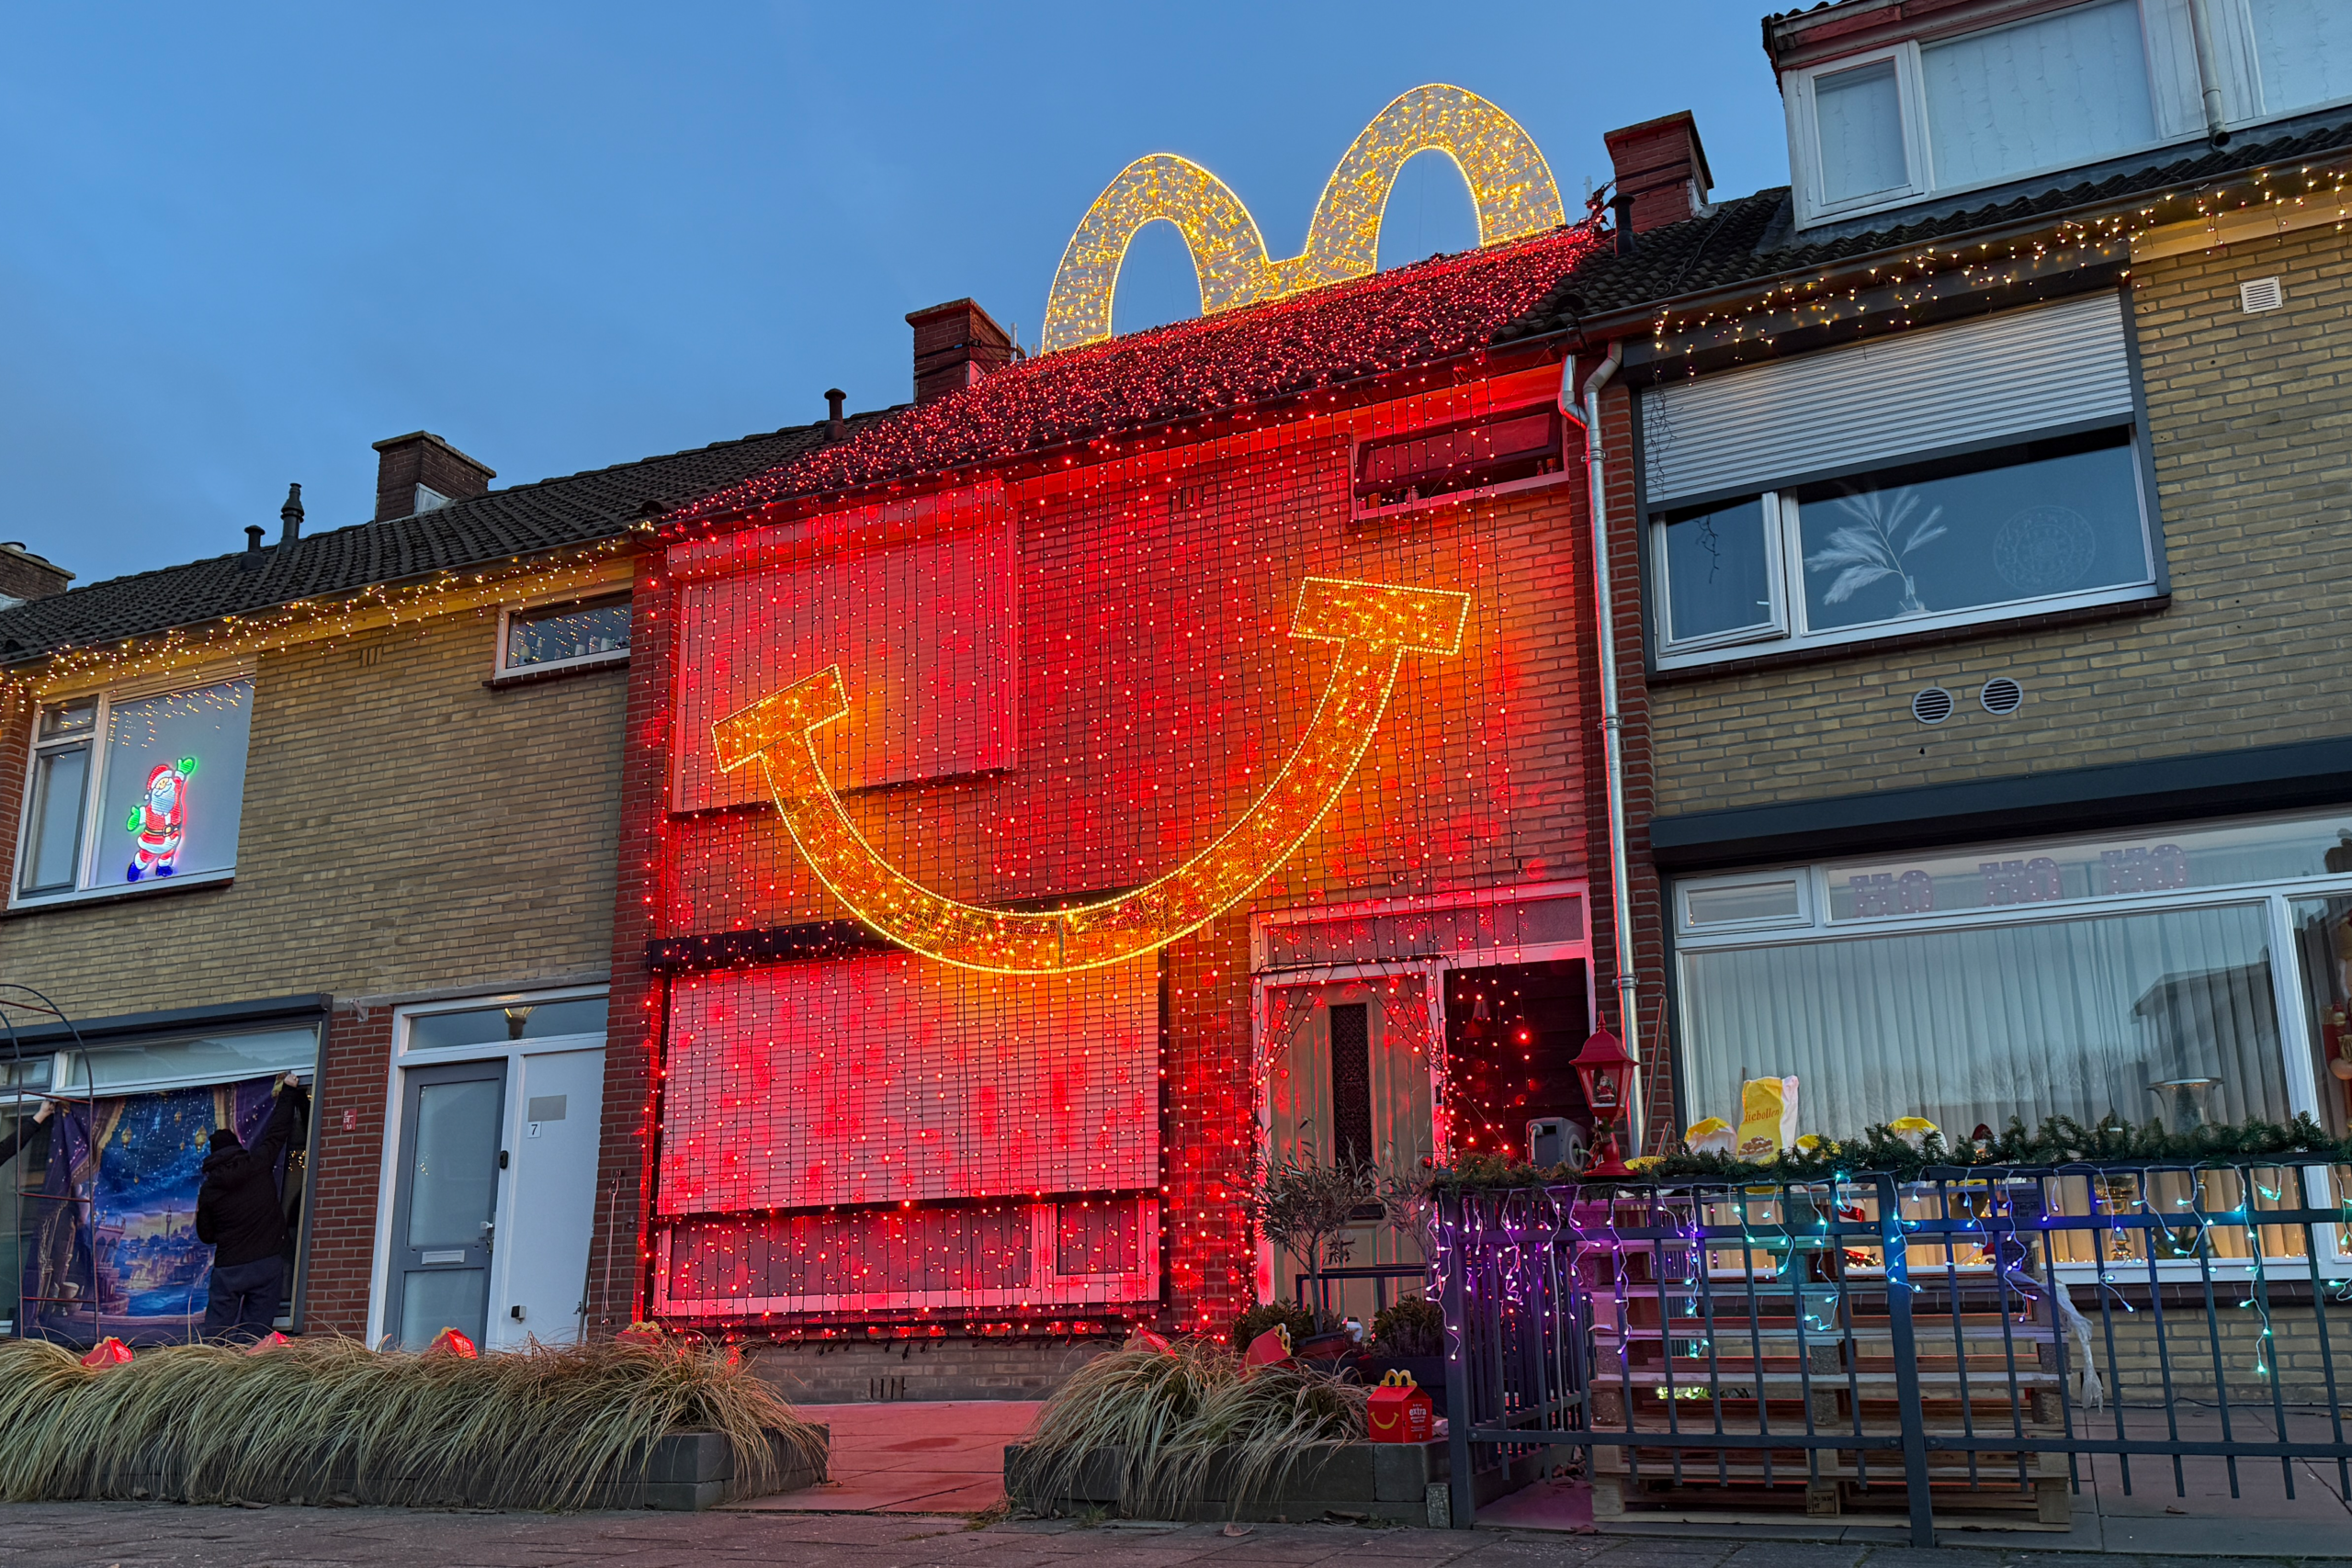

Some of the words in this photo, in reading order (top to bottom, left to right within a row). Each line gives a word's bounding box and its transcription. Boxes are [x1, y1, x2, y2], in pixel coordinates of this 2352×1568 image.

[1745, 1108, 1780, 1122] liebollen
[531, 1123, 538, 1135] 7
[1408, 1407, 1427, 1416] extra
